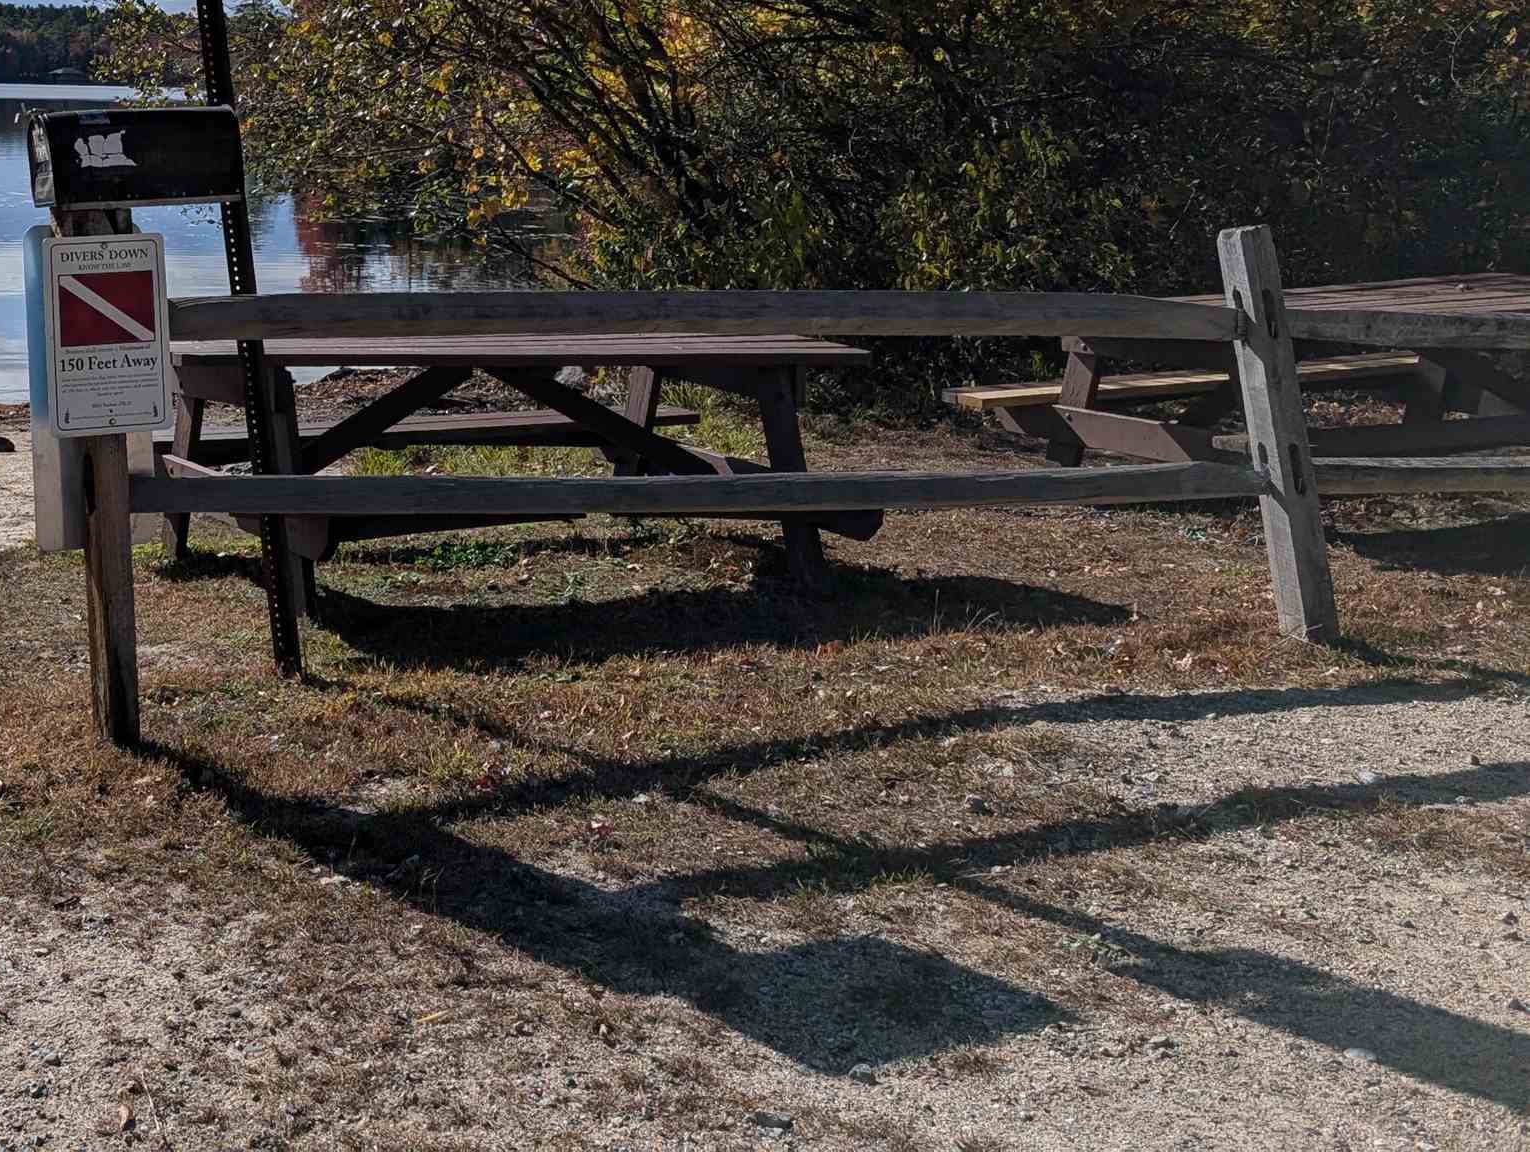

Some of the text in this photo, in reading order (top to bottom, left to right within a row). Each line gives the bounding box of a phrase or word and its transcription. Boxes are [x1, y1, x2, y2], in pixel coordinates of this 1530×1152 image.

[60, 248, 149, 263] DIVERS DOWN
[60, 354, 158, 373] 150 Feet Away
